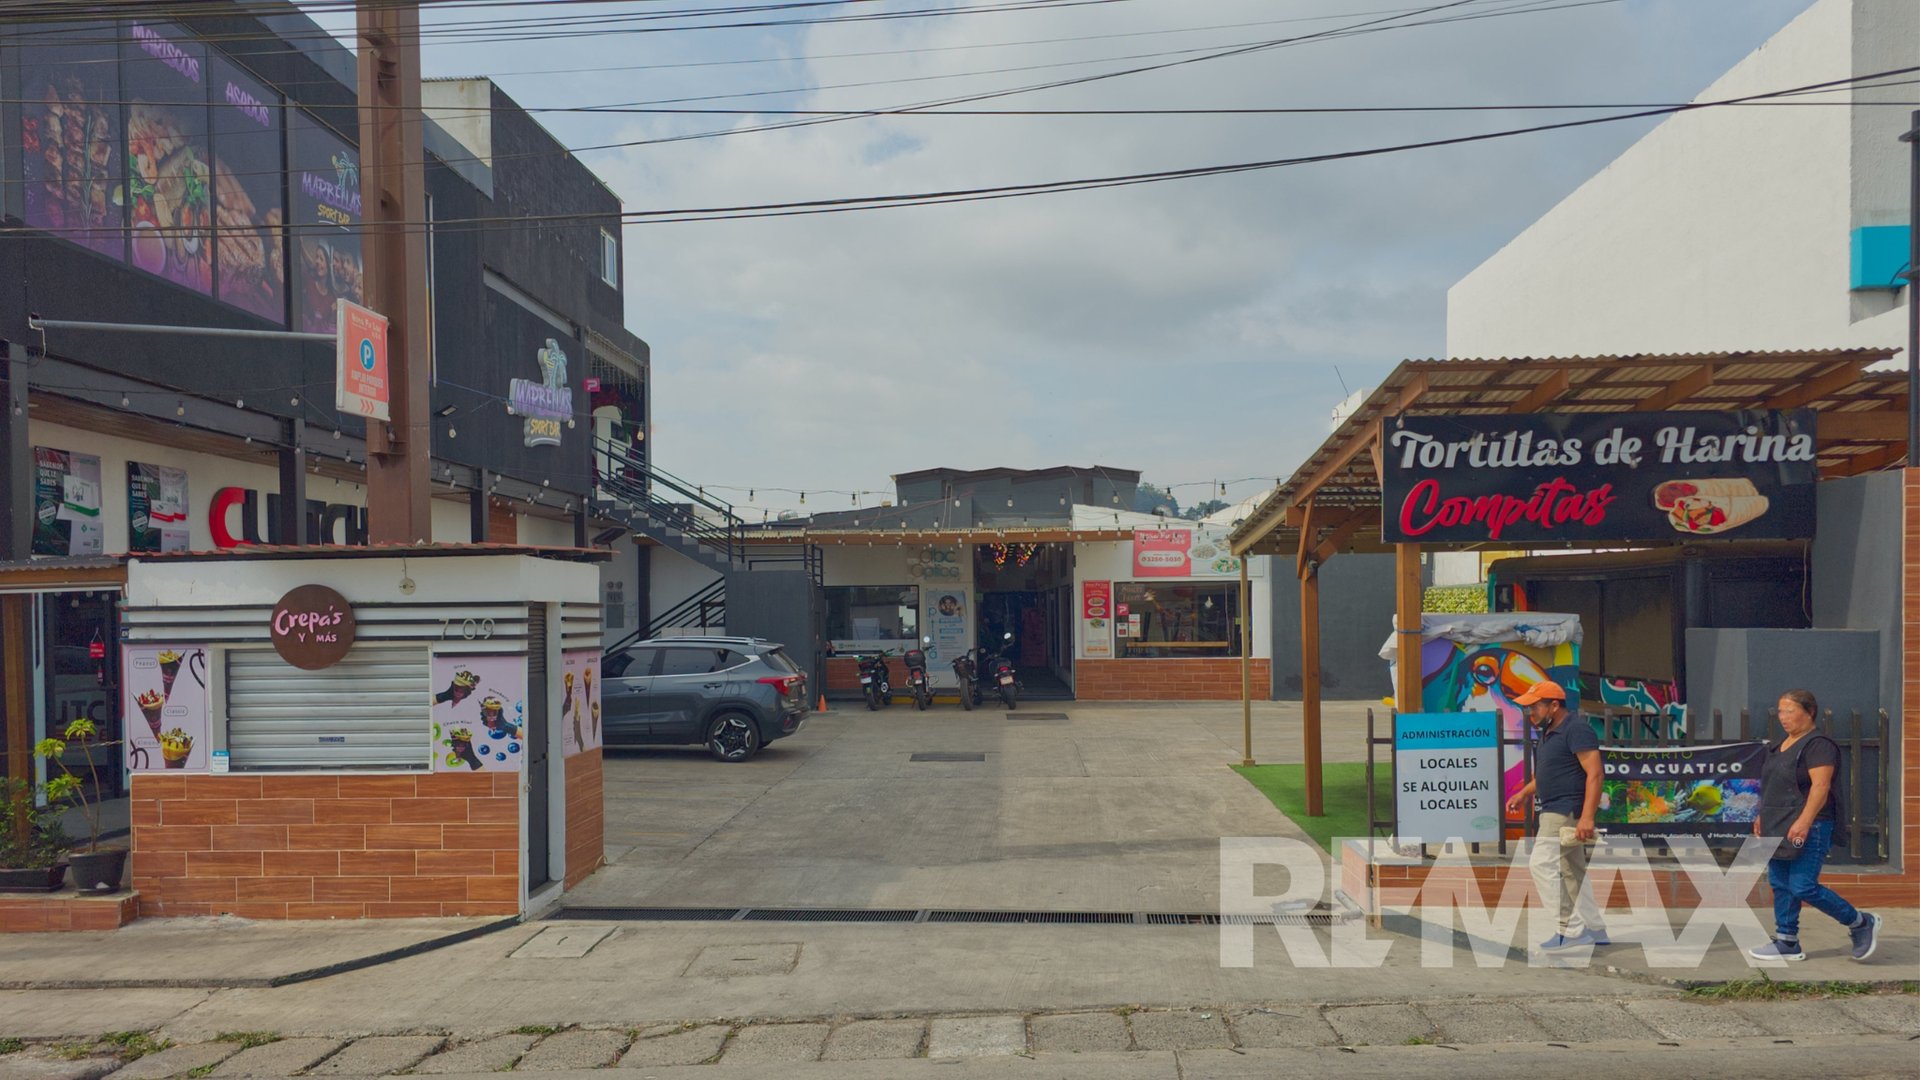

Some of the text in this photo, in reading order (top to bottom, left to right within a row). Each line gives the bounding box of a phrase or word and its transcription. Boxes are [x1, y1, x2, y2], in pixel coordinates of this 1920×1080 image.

[132, 20, 200, 84] MARISCOS
[226, 81, 270, 127] ASADOS
[1391, 425, 1816, 469] Tortillas de Harina
[1399, 476, 1618, 540] Compitas
[439, 617, 496, 640] 709
[298, 631, 337, 643] Y MÁS
[1401, 728, 1490, 740] ADMINISTRACIÓN
[1607, 751, 1693, 760] ACUARIO
[1420, 757, 1478, 769] LOCALES
[1640, 762, 1743, 775] ACUATICO
[1402, 780, 1489, 793] SE ALQUILAN
[1420, 798, 1478, 810] LOCALES
